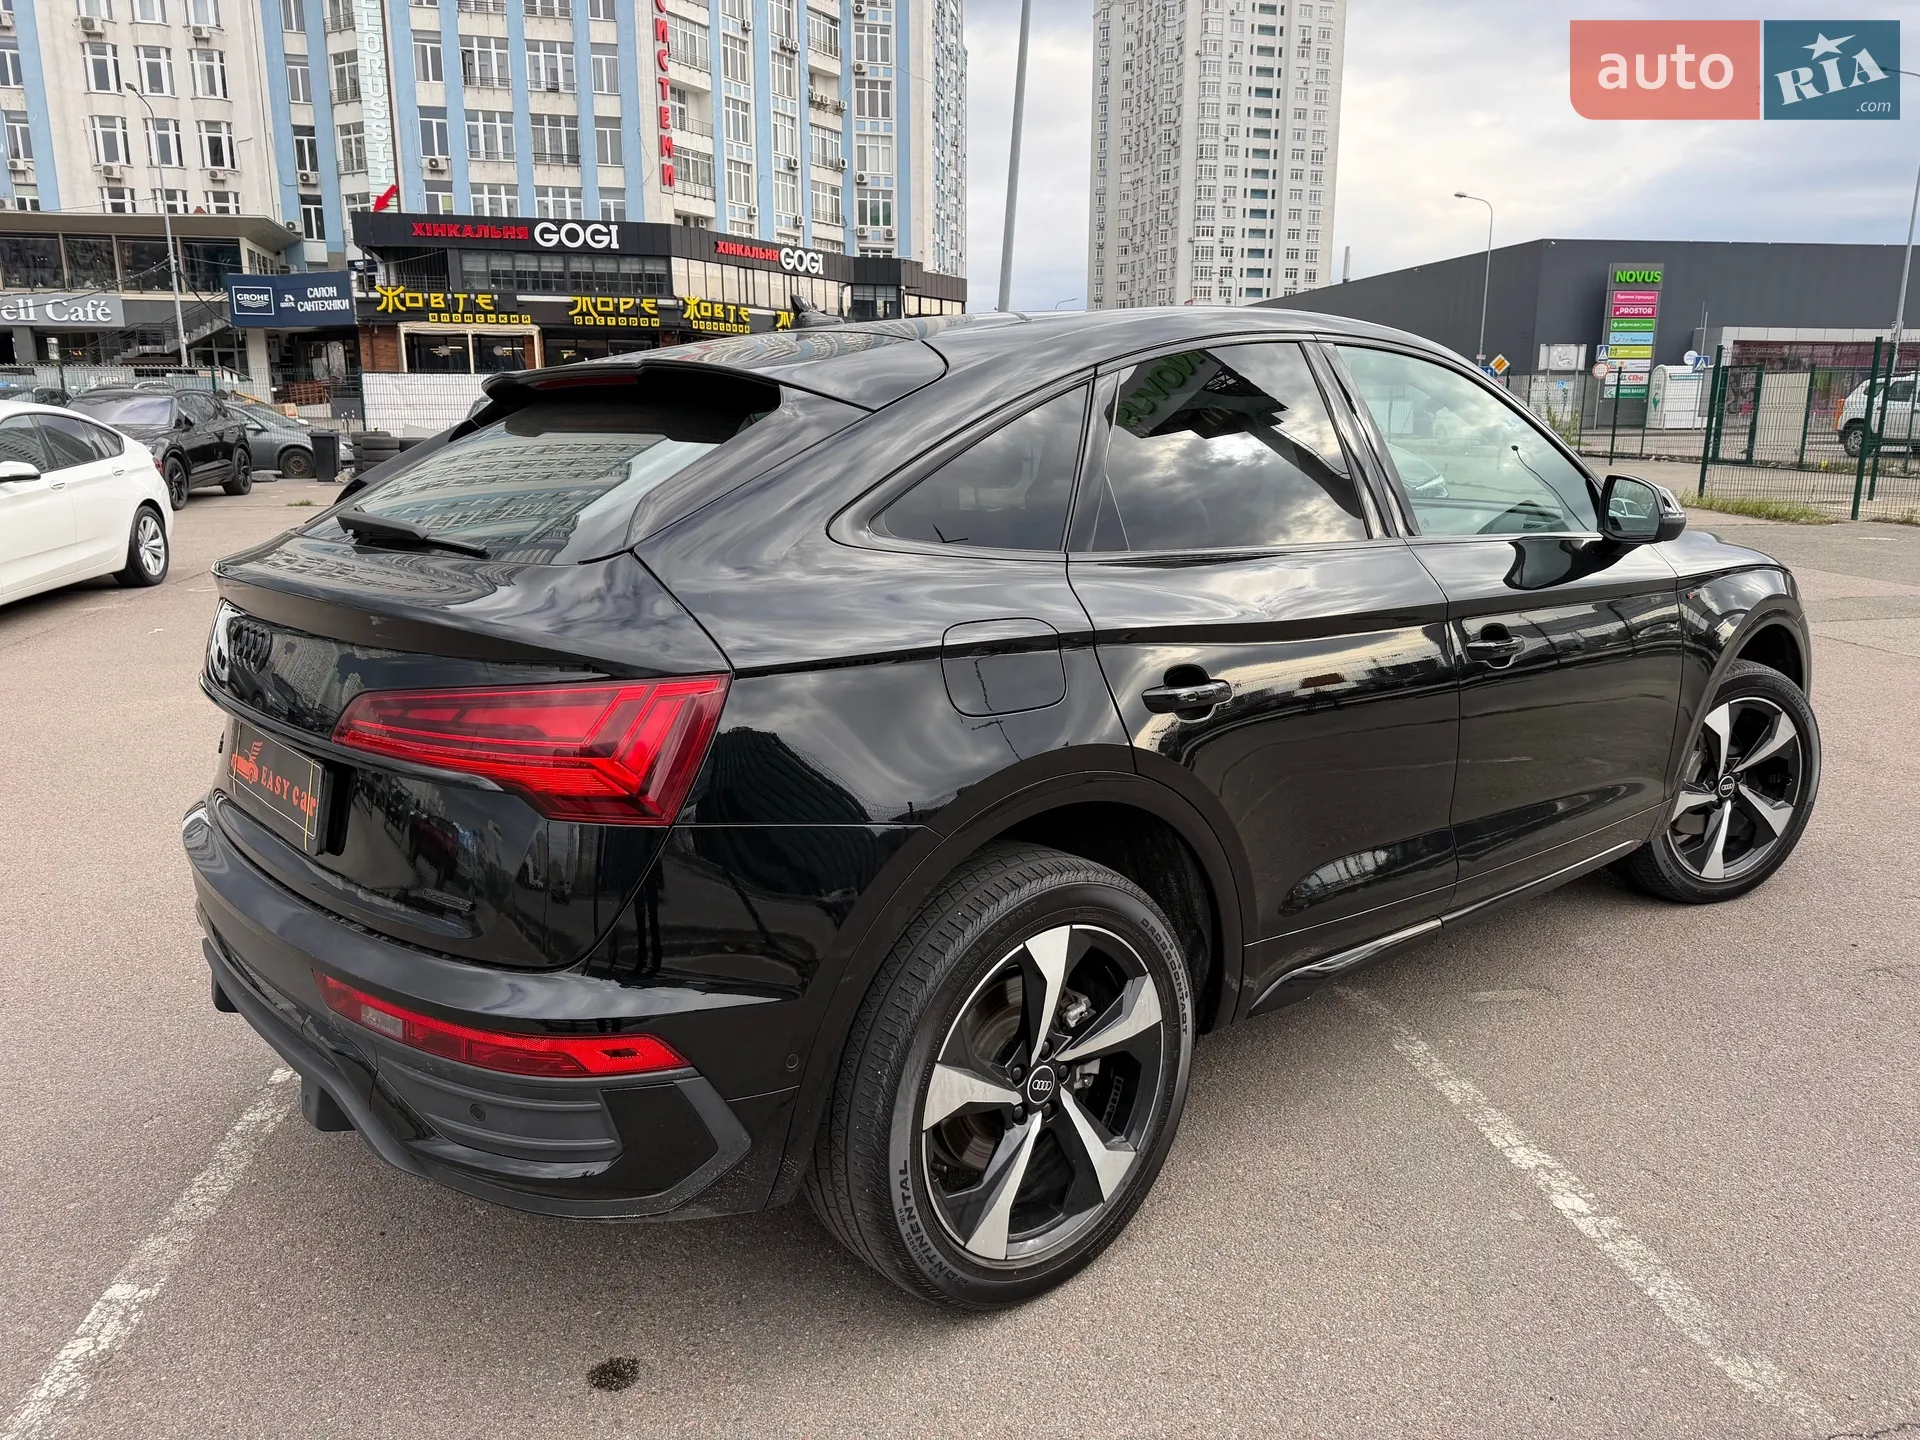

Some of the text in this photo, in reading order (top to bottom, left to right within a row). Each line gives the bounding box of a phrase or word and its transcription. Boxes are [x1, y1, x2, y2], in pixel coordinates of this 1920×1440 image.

[411, 221, 620, 249] ХІНКАЛЬНЯ GOGI
[715, 240, 824, 275] ХІНКАЛЬНЯ GOGI
[1615, 270, 1662, 283] NOVUS
[236, 293, 270, 302] GROHE
[307, 286, 338, 299] САЛОН
[374, 285, 495, 313] ЖОВТЕ
[0, 298, 112, 322] ell Café
[297, 299, 350, 313] САНТЕХНІКИ
[568, 297, 659, 318] МОРЕ
[1619, 307, 1653, 315] PROSTOR
[573, 315, 660, 327] ресторан
[260, 765, 291, 800] EASY
[898, 1159, 970, 1288] CONTINENTAL
